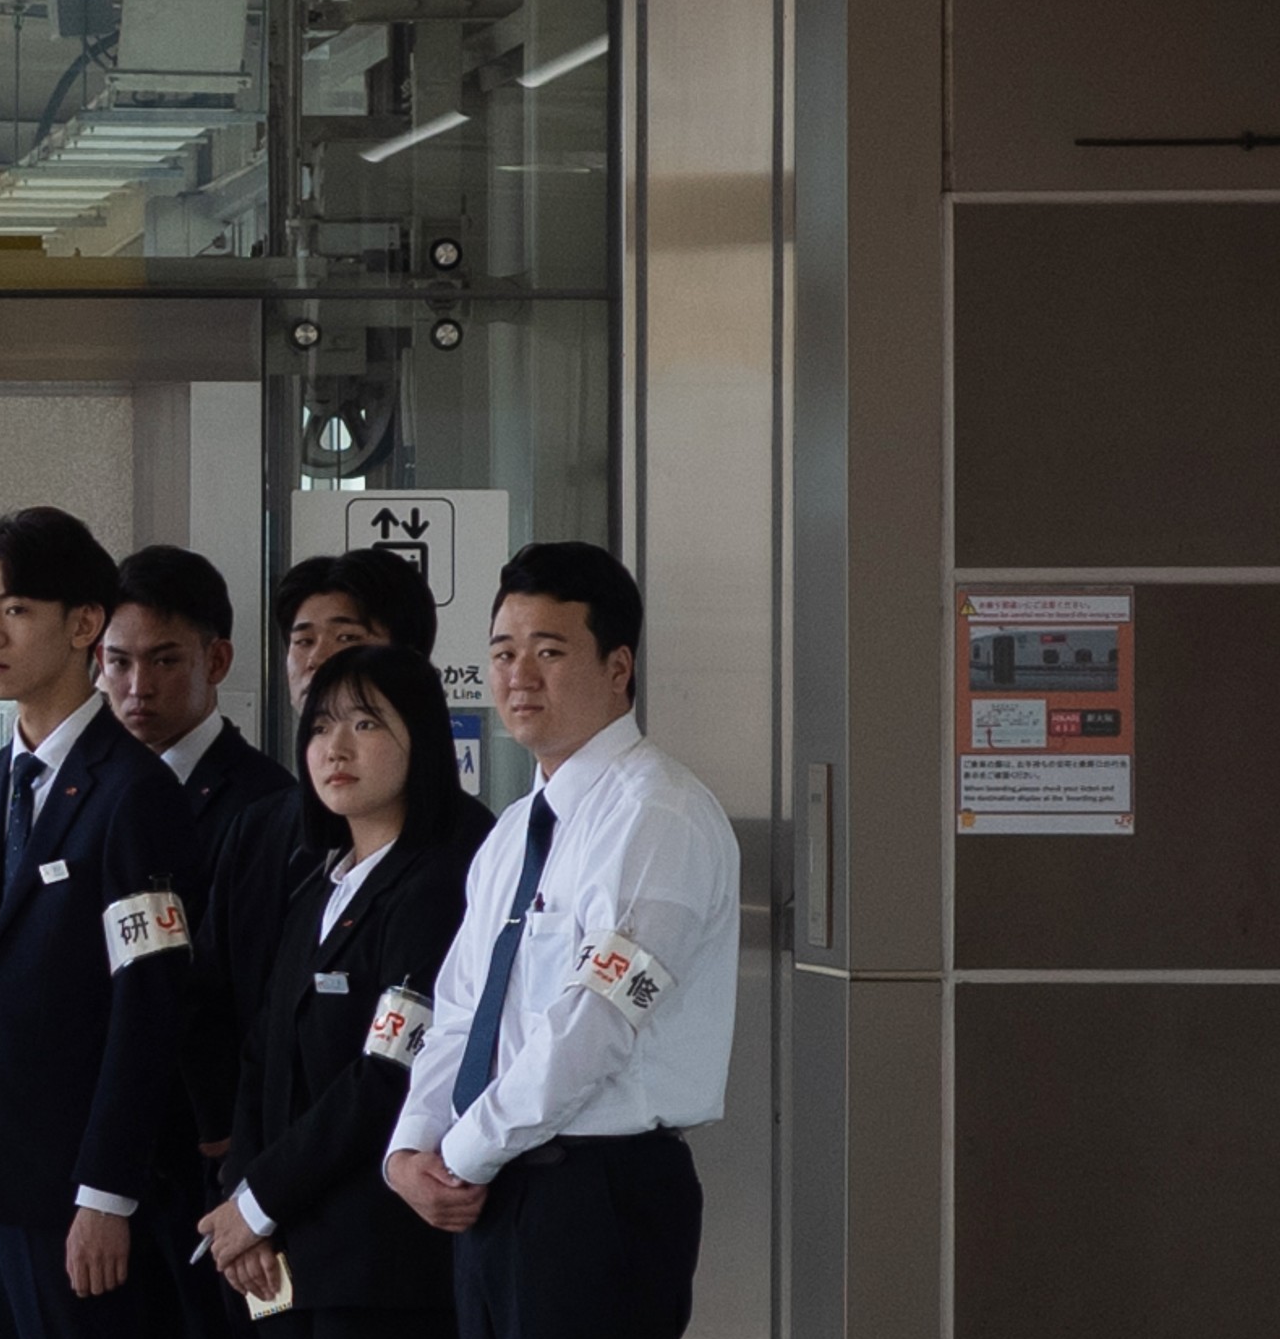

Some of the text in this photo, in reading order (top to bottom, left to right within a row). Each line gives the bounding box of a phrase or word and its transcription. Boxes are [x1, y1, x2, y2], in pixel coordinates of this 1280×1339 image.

[443, 665, 484, 685] かえ
[117, 910, 150, 946] 研
[592, 951, 631, 980] JR
[625, 969, 661, 1009] 修
[373, 1011, 406, 1037] JR
